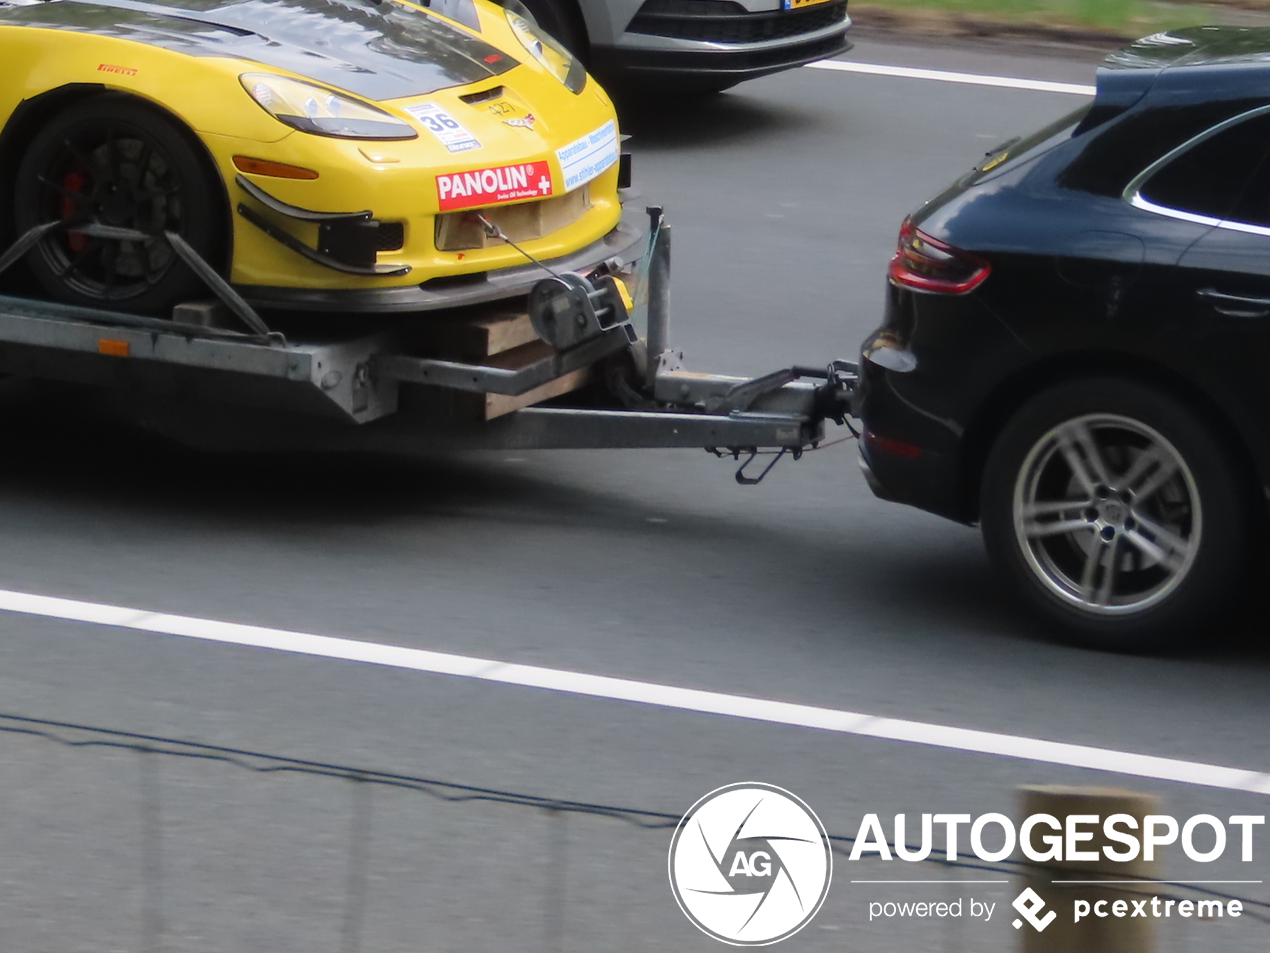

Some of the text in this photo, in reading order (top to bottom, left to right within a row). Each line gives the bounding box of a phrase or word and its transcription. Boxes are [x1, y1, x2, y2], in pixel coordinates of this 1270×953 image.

[97, 63, 139, 77] PIRELLI
[488, 101, 517, 117] 427
[420, 113, 459, 132] 36
